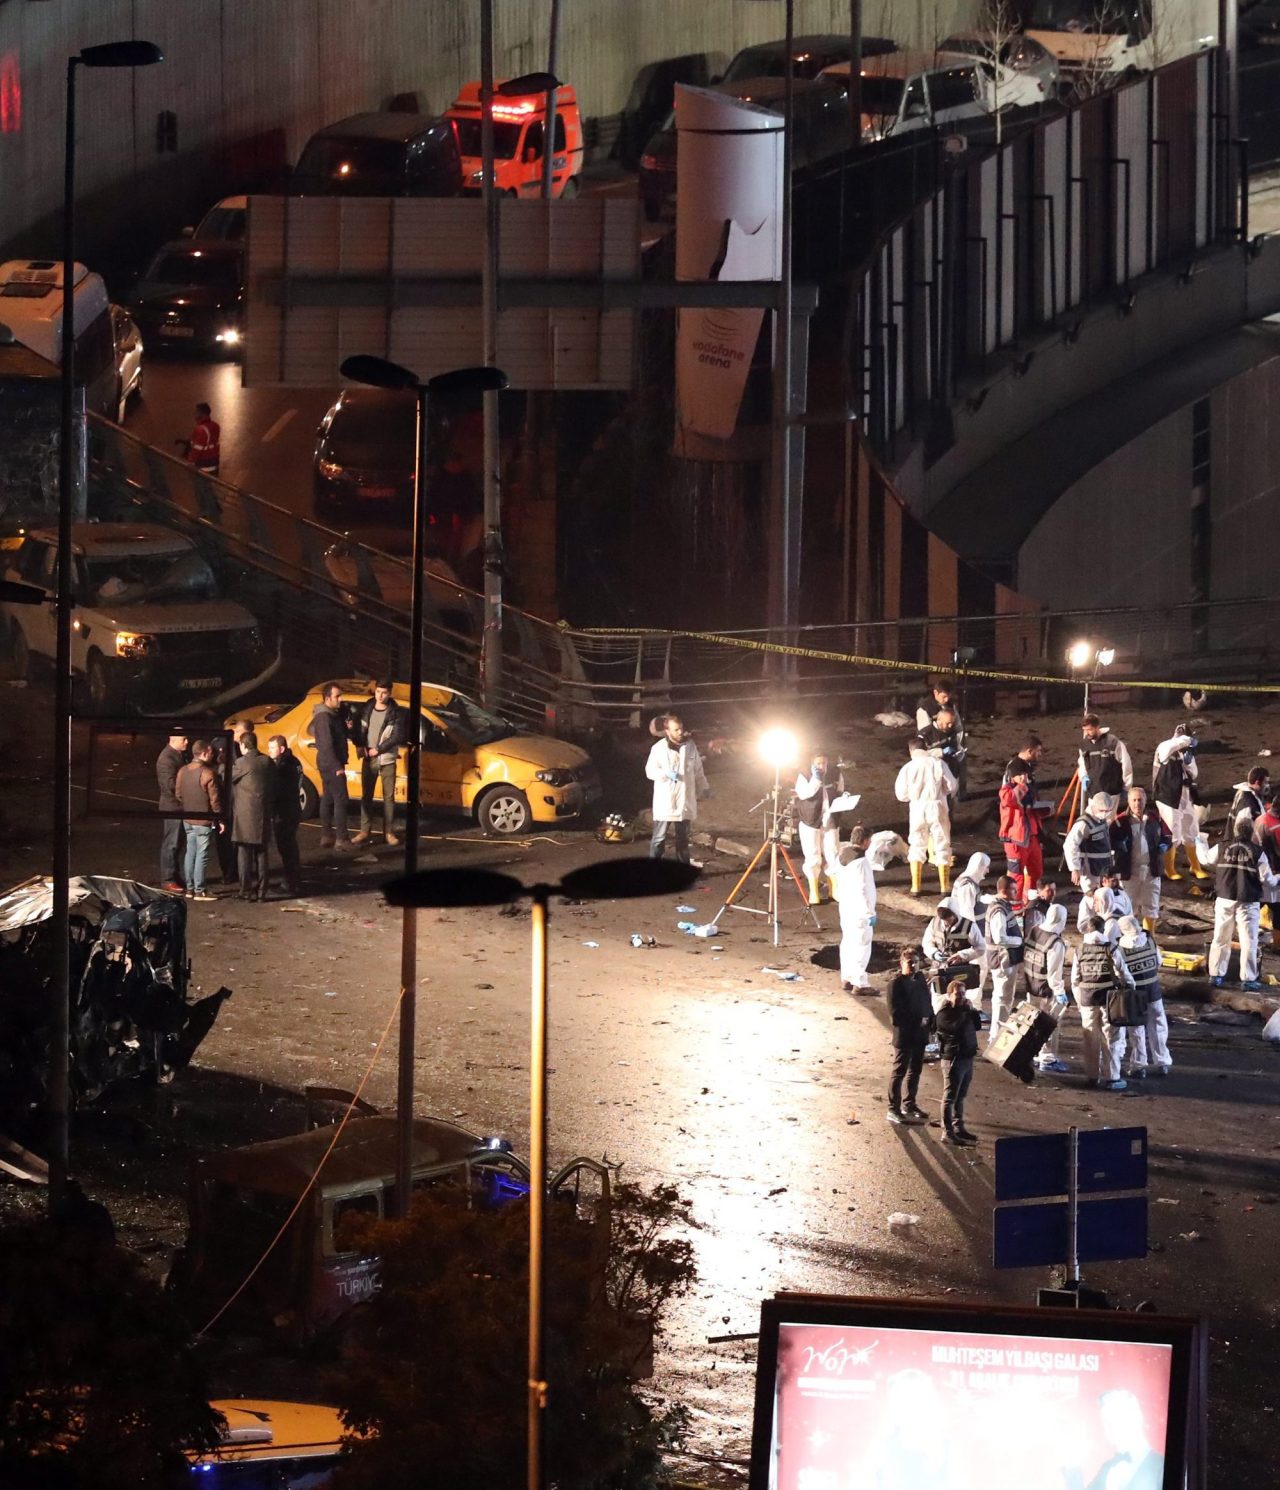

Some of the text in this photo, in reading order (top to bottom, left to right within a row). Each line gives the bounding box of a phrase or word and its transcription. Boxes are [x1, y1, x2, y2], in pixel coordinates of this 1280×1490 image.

[692, 341, 745, 361] vodafone
[699, 354, 731, 368] arena
[931, 1345, 1099, 1374] MUHTEŞEM YILBAŞI GALASI
